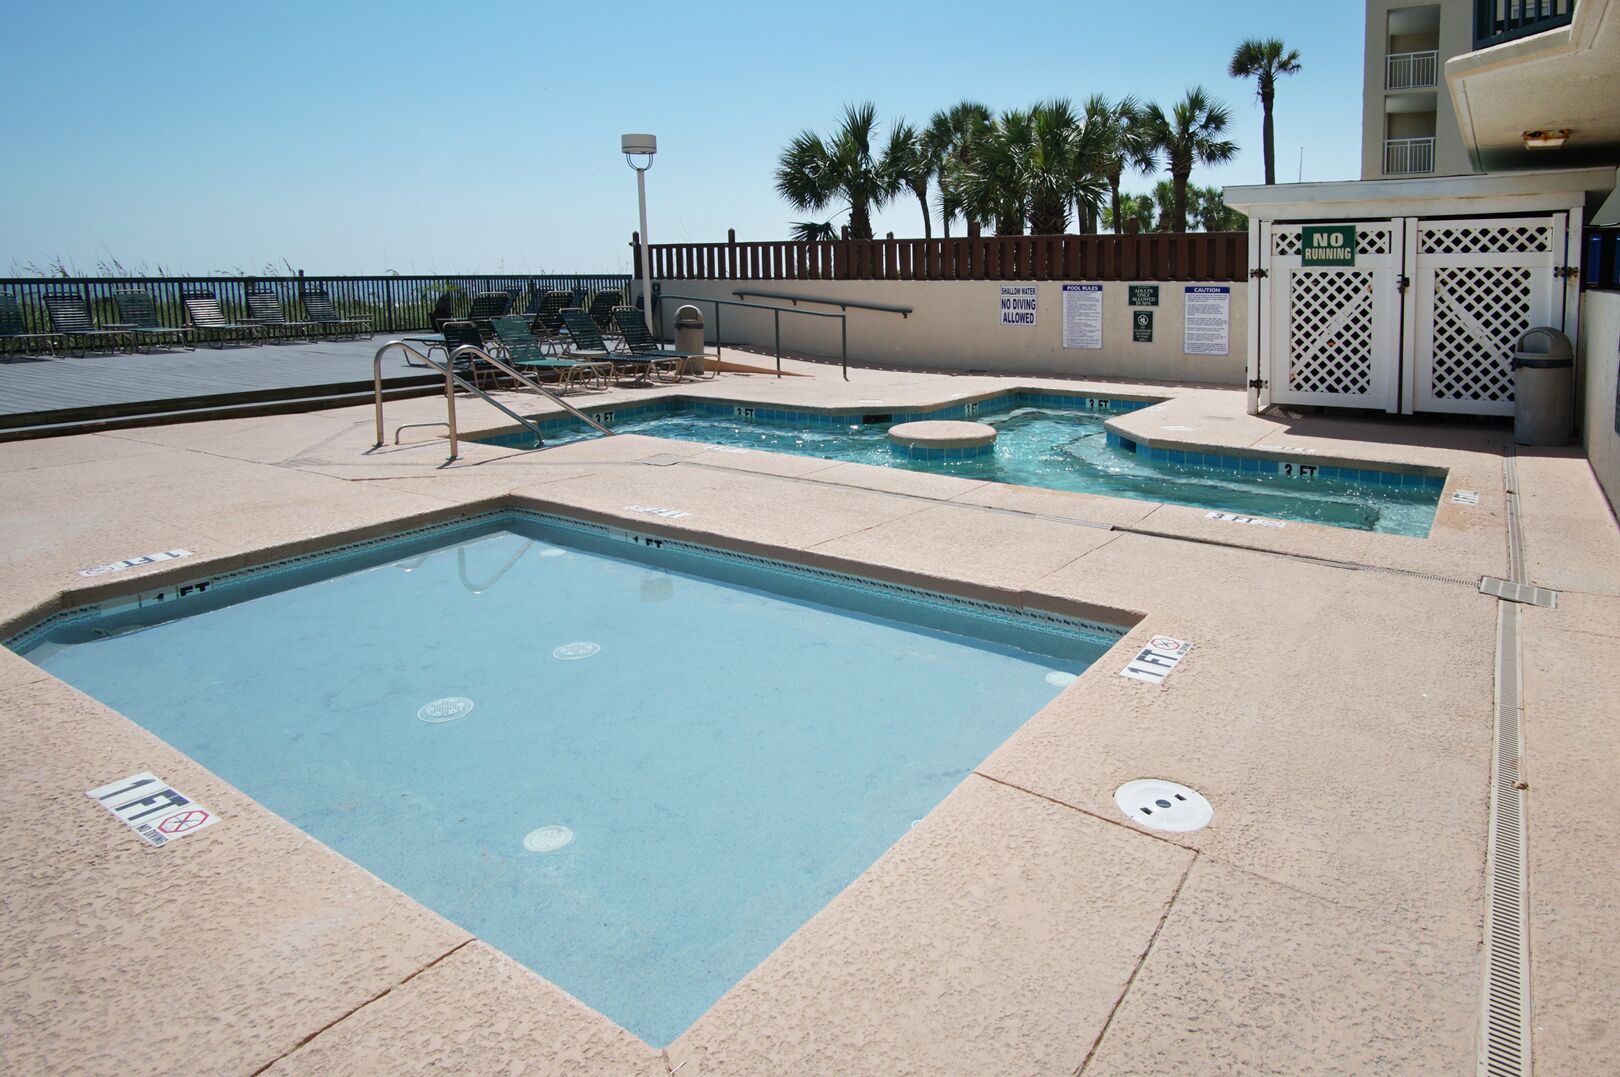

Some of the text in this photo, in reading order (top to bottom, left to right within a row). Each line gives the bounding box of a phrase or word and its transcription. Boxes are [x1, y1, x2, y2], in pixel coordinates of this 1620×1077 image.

[1312, 232, 1344, 247] NO
[1305, 247, 1351, 260] RUNNING
[1001, 287, 1036, 295] SHALLOW WATER
[1001, 298, 1036, 310] NO DIVING
[1002, 312, 1035, 324] ALLOWED
[1300, 464, 1317, 477] FT
[645, 537, 663, 549] FT
[179, 581, 210, 597] FT
[1127, 648, 1178, 678] 1 FT
[98, 779, 191, 821] 1 FT
